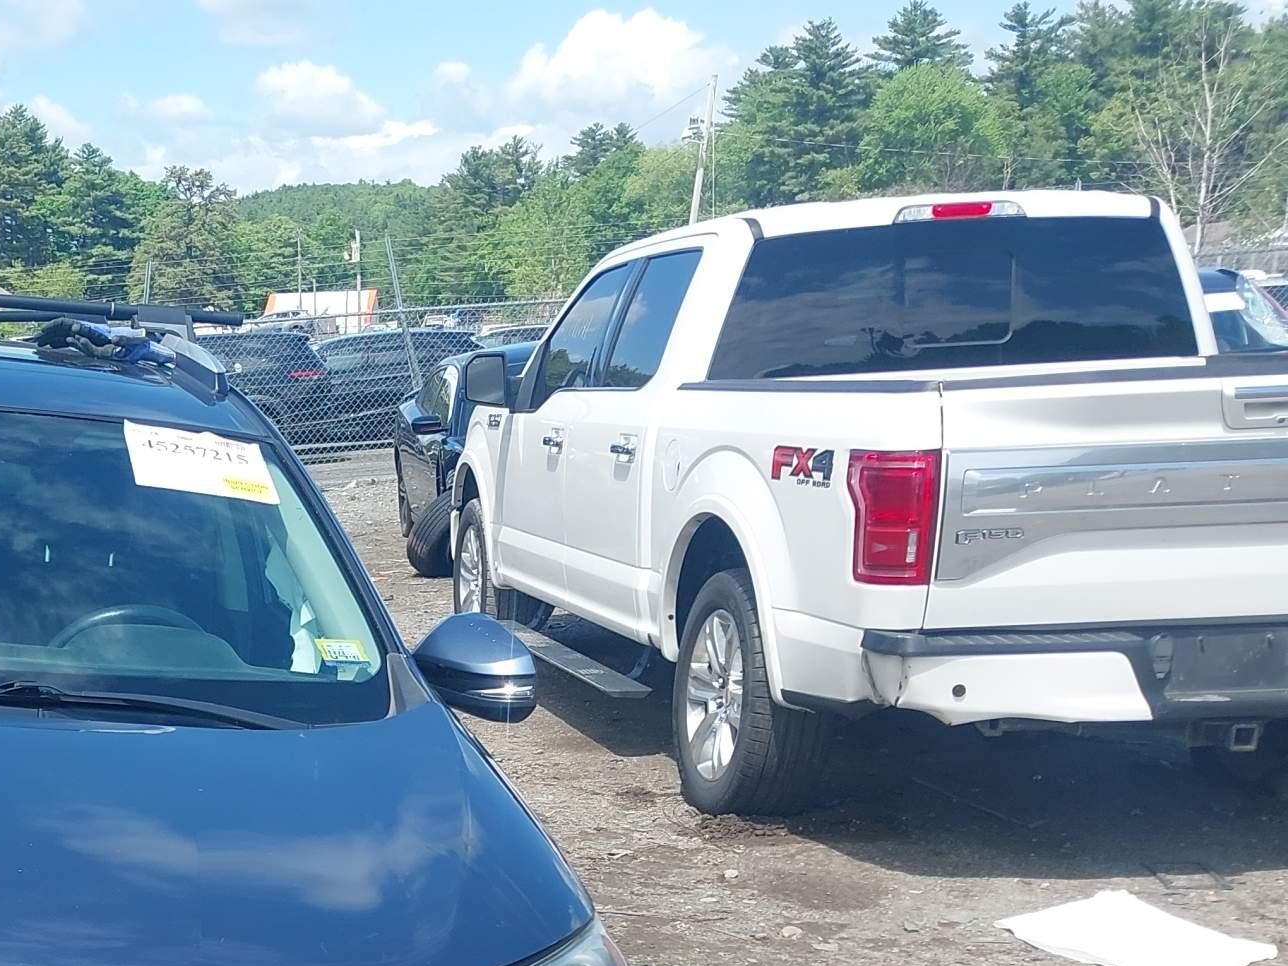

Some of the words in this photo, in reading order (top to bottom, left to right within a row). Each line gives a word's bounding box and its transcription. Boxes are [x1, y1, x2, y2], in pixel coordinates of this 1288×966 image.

[142, 439, 249, 464] 45257215
[772, 445, 835, 481] FX4
[812, 480, 831, 488] ROAD
